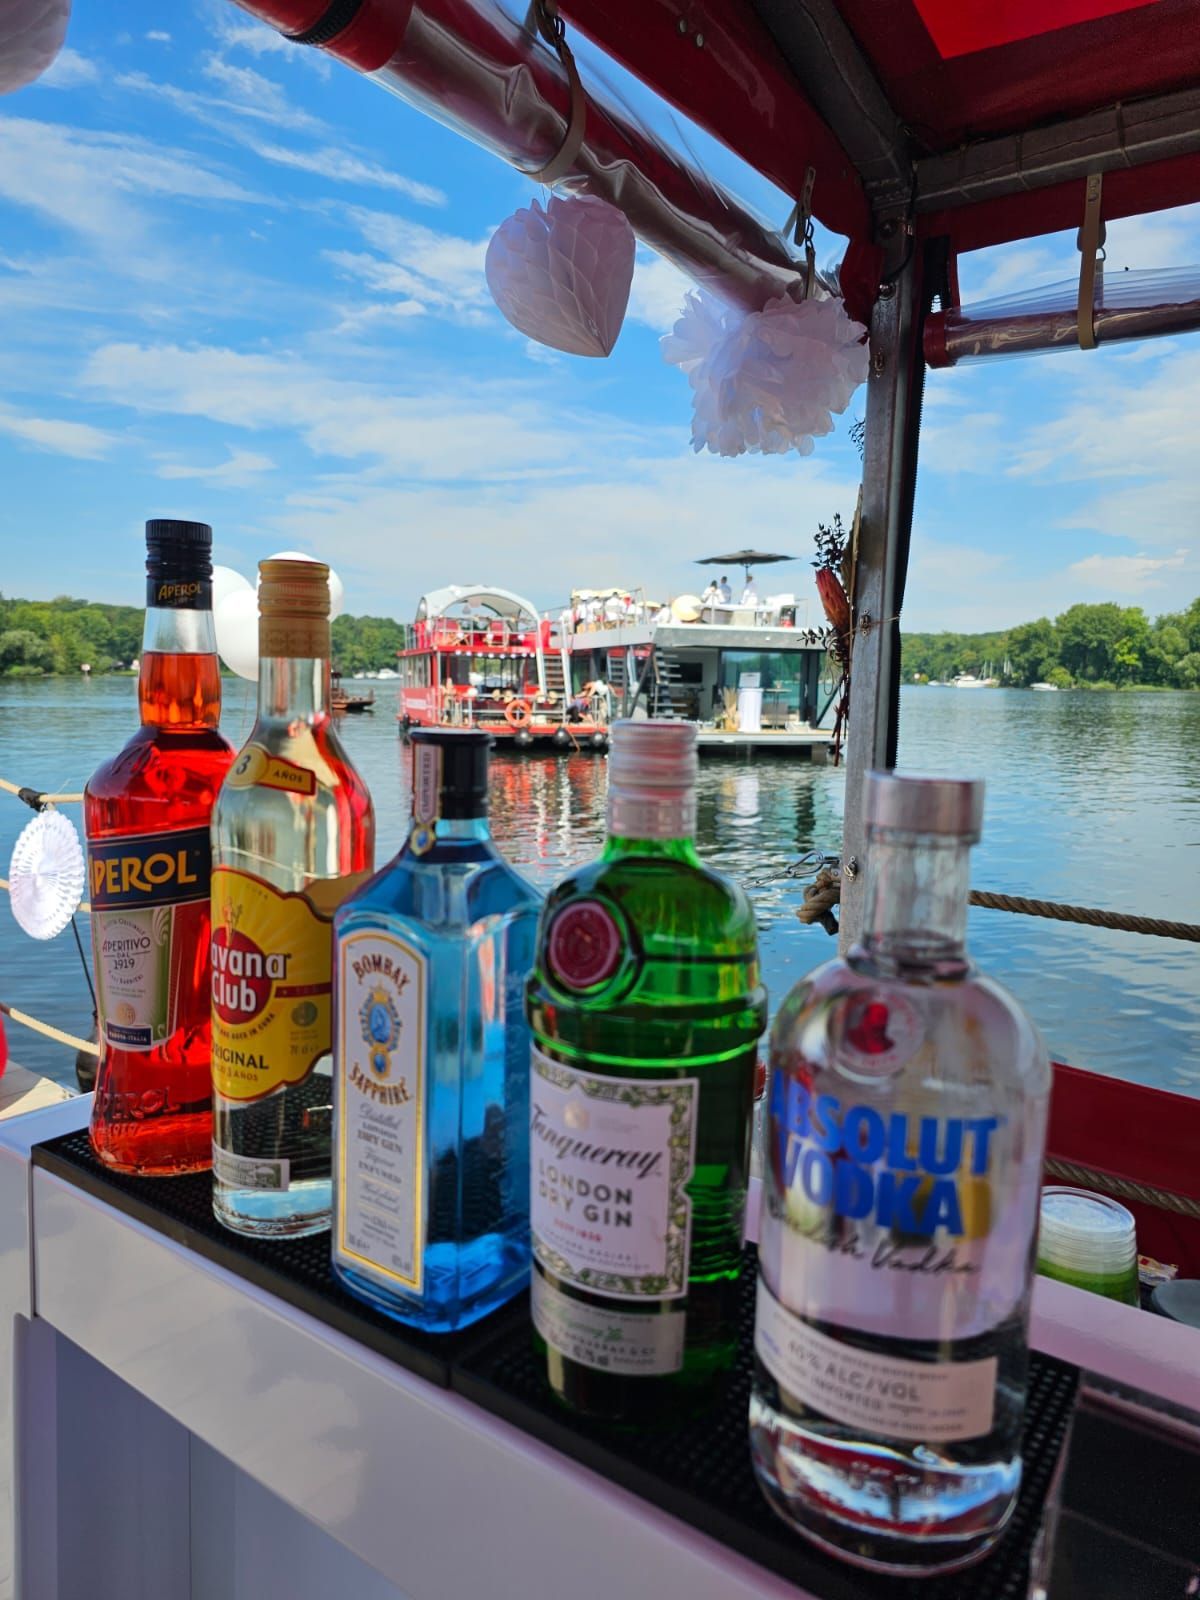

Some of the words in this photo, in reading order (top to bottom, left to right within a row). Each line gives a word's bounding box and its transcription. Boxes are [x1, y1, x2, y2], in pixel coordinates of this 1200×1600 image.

[158, 583, 202, 600] APEROL
[235, 754, 251, 775] 3
[103, 936, 151, 952] APERITIVO
[114, 958, 136, 970] 1919
[211, 970, 257, 1013] Club
[352, 953, 411, 996] BOMBAY
[349, 1061, 414, 1106] SAPPHIRE
[532, 1103, 663, 1179] Tanqueray
[770, 1066, 999, 1177] ABSOLUT
[538, 1179, 574, 1212] DRY
[582, 1202, 633, 1228] GIN
[539, 1158, 633, 1206] LONDON
[782, 1128, 965, 1237] VODKA
[824, 1361, 920, 1402] ALC/VOL
